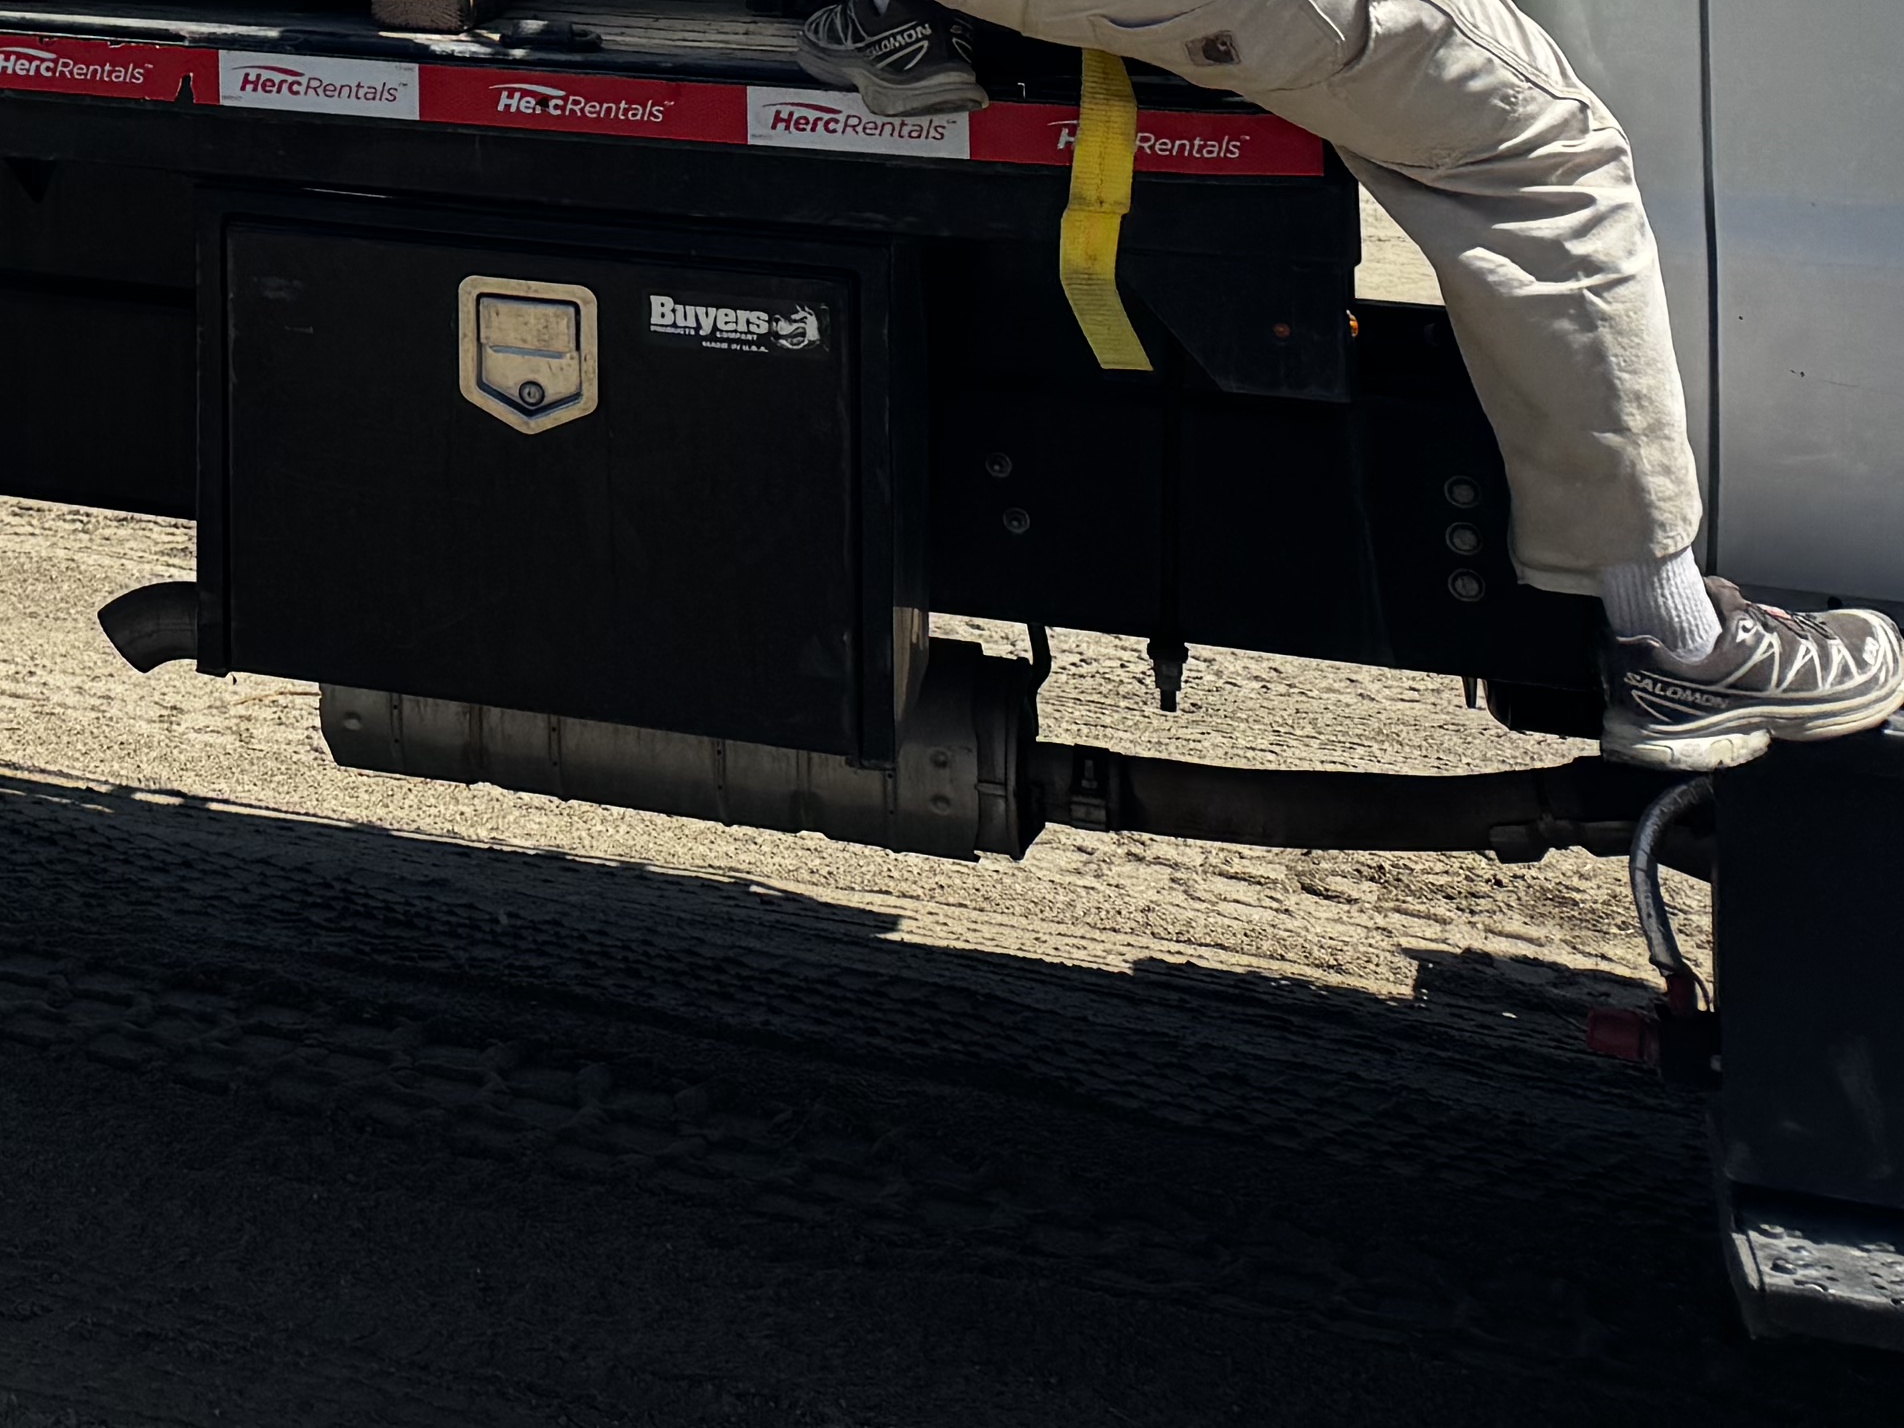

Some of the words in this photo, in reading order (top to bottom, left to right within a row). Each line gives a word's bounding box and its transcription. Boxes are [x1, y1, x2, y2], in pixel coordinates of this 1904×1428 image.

[1057, 128, 1242, 158] HRentals
[650, 295, 769, 335] Buyers
[1624, 671, 1730, 709] SALOMON
